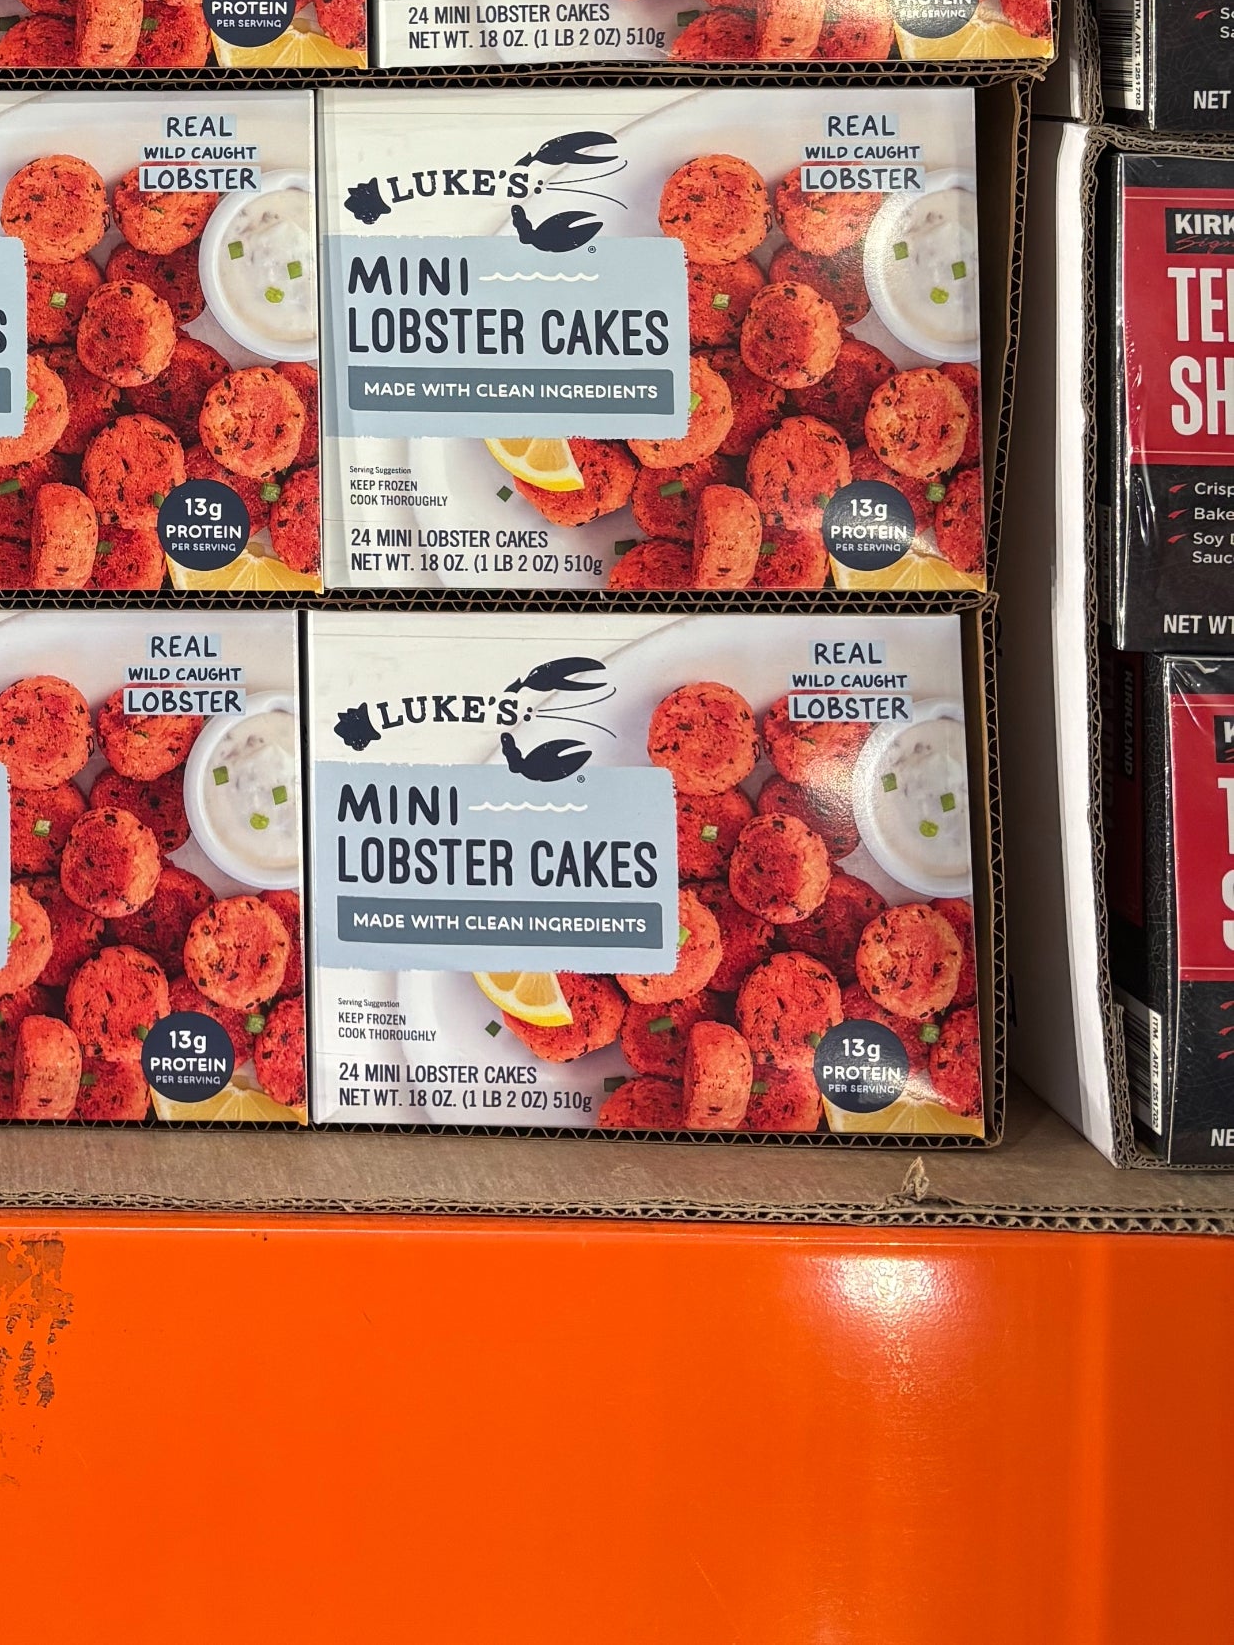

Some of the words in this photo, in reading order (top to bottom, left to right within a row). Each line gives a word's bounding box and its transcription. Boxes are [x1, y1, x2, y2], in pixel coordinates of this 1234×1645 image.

[408, 7, 428, 24] 24
[435, 6, 470, 24] MINI
[477, 5, 550, 24] LOBSTER
[556, 4, 610, 22] CAKES
[1193, 90, 1231, 110] NET
[167, 116, 232, 137] REAL
[144, 147, 185, 159] WILD
[192, 147, 258, 159] CAUGHT
[144, 168, 256, 189] LOBSTER
[348, 256, 469, 297] MINI
[349, 308, 525, 355] LOBSTER
[542, 309, 670, 355] CAKES
[364, 382, 415, 396] MADE
[422, 383, 470, 397] WITH
[476, 384, 535, 398] CLEAN
[541, 385, 657, 399] INGREDIENTS
[1194, 482, 1234, 497] Crisp
[1194, 507, 1234, 521] Bake
[1193, 532, 1224, 548] Soy
[1192, 550, 1234, 564] Sauc
[1163, 614, 1203, 634] NET
[1124, 670, 1134, 776] KIRKLAND
[337, 783, 457, 826] MINI
[338, 837, 513, 885] LOBSTER
[531, 840, 658, 889] CAKES
[170, 1030, 207, 1053] 13g
[150, 1058, 226, 1072] PROTEIN
[339, 1063, 359, 1080] 24
[365, 1064, 400, 1082] MINI
[406, 1065, 478, 1083] LOBSTER
[484, 1066, 538, 1084] CAKES
[156, 1075, 174, 1084] PER
[177, 1076, 221, 1084] SERVING
[1210, 1128, 1234, 1147] NE
